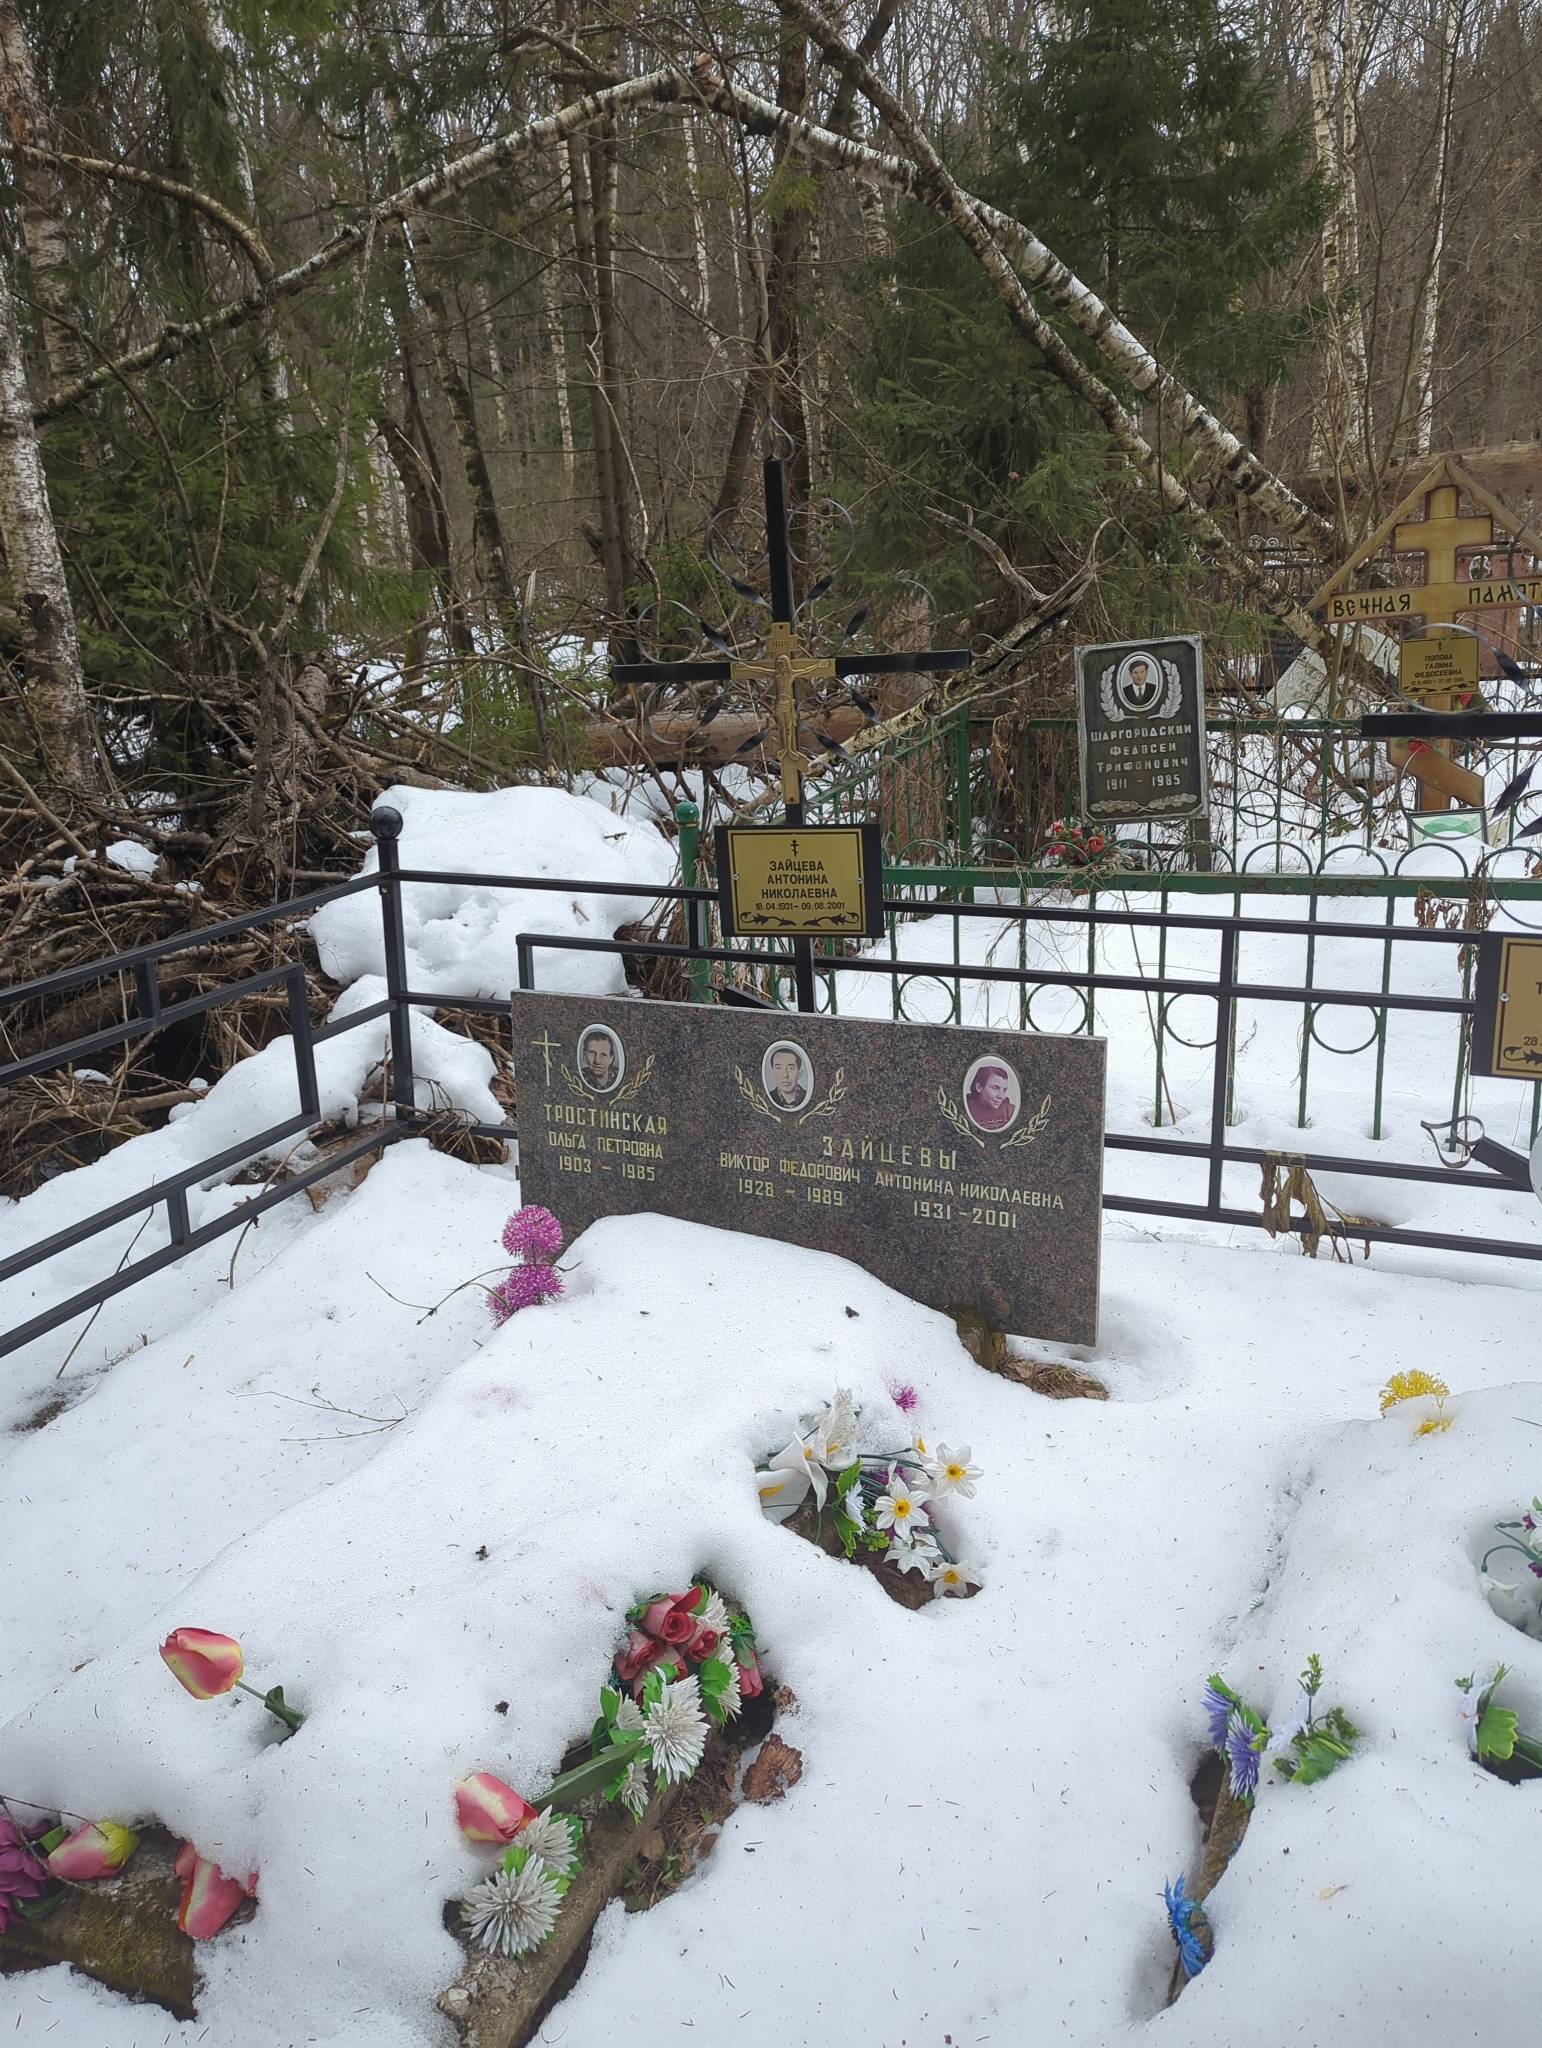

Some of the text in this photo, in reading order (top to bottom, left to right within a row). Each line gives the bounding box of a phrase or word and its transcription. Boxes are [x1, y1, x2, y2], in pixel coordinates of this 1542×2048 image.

[1333, 582, 1542, 617] ВЕЧНАЯ ПАМЯТ
[1425, 653, 1454, 662] ПОПОВА
[1425, 662, 1454, 670] ГАЛИНА
[1414, 669, 1462, 678] ФЕДОСЕЕВНА
[1090, 724, 1192, 742] ШАРГОРОДСКИЙ
[1096, 757, 1189, 773] ТРИФОНОВИЧ
[1106, 778, 1128, 790] 1911
[1152, 773, 1181, 787] 1985
[769, 859, 825, 873] ЗАЙЦЕВА
[767, 874, 829, 885] АНТОНИНА
[761, 887, 838, 899] НИКОЛАЕВНА
[543, 1103, 667, 1135] ТРОСТИНСКАЯ
[549, 1131, 663, 1159] ОЛЬГА ПЕТРОВНА
[822, 1135, 957, 1171] ЗАЙЦЕВЫ
[559, 1155, 592, 1173] 1903
[622, 1162, 655, 1181] 1985
[720, 1151, 861, 1184] ВИКТОР ФЕДОРОВИЧ
[738, 1178, 774, 1197] 1928
[807, 1186, 843, 1207] 1989
[874, 1171, 1064, 1210] АНТОНИНА НИКОЛАЕВНА
[913, 1200, 951, 1219] 1931
[972, 1207, 1017, 1229] 2001
